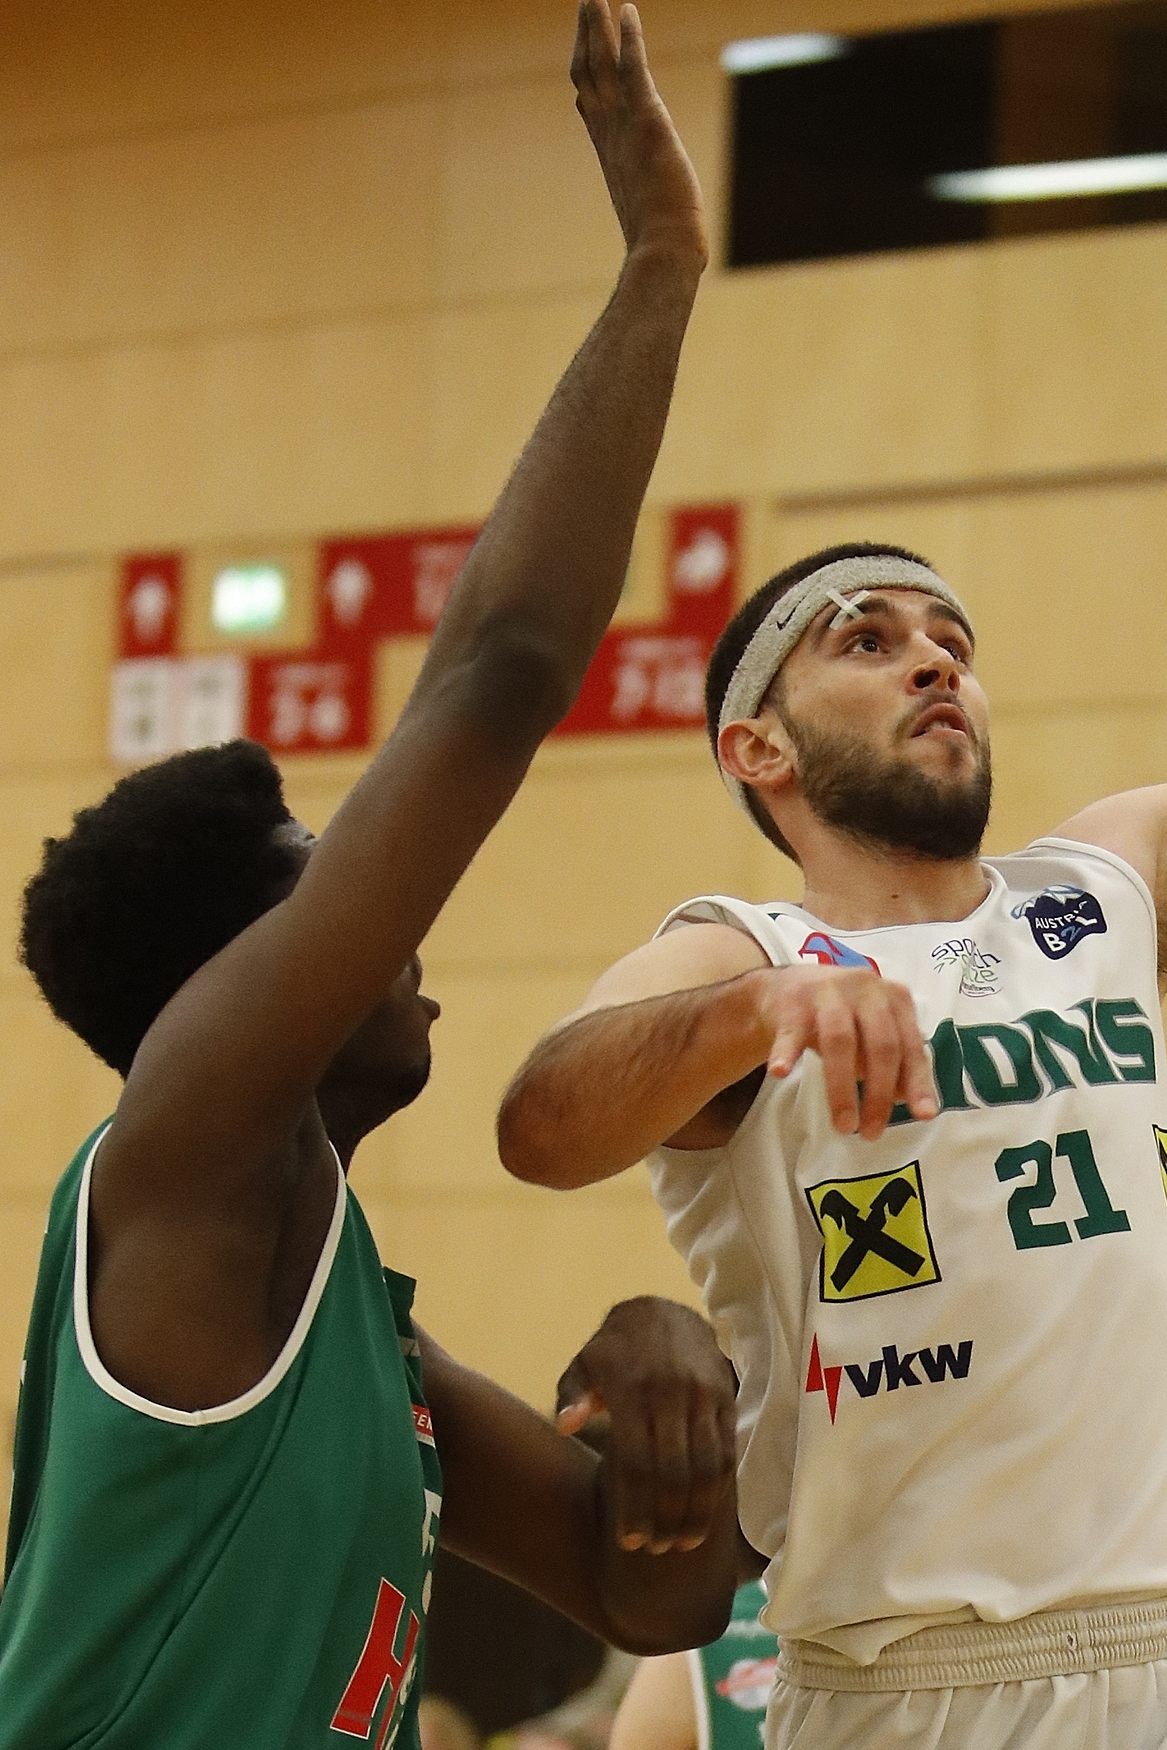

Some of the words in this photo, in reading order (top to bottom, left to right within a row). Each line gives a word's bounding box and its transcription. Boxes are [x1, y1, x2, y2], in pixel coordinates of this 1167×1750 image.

[856, 997, 1157, 1128] IONS
[994, 1129, 1131, 1250] 21
[845, 1340, 973, 1398] vkw
